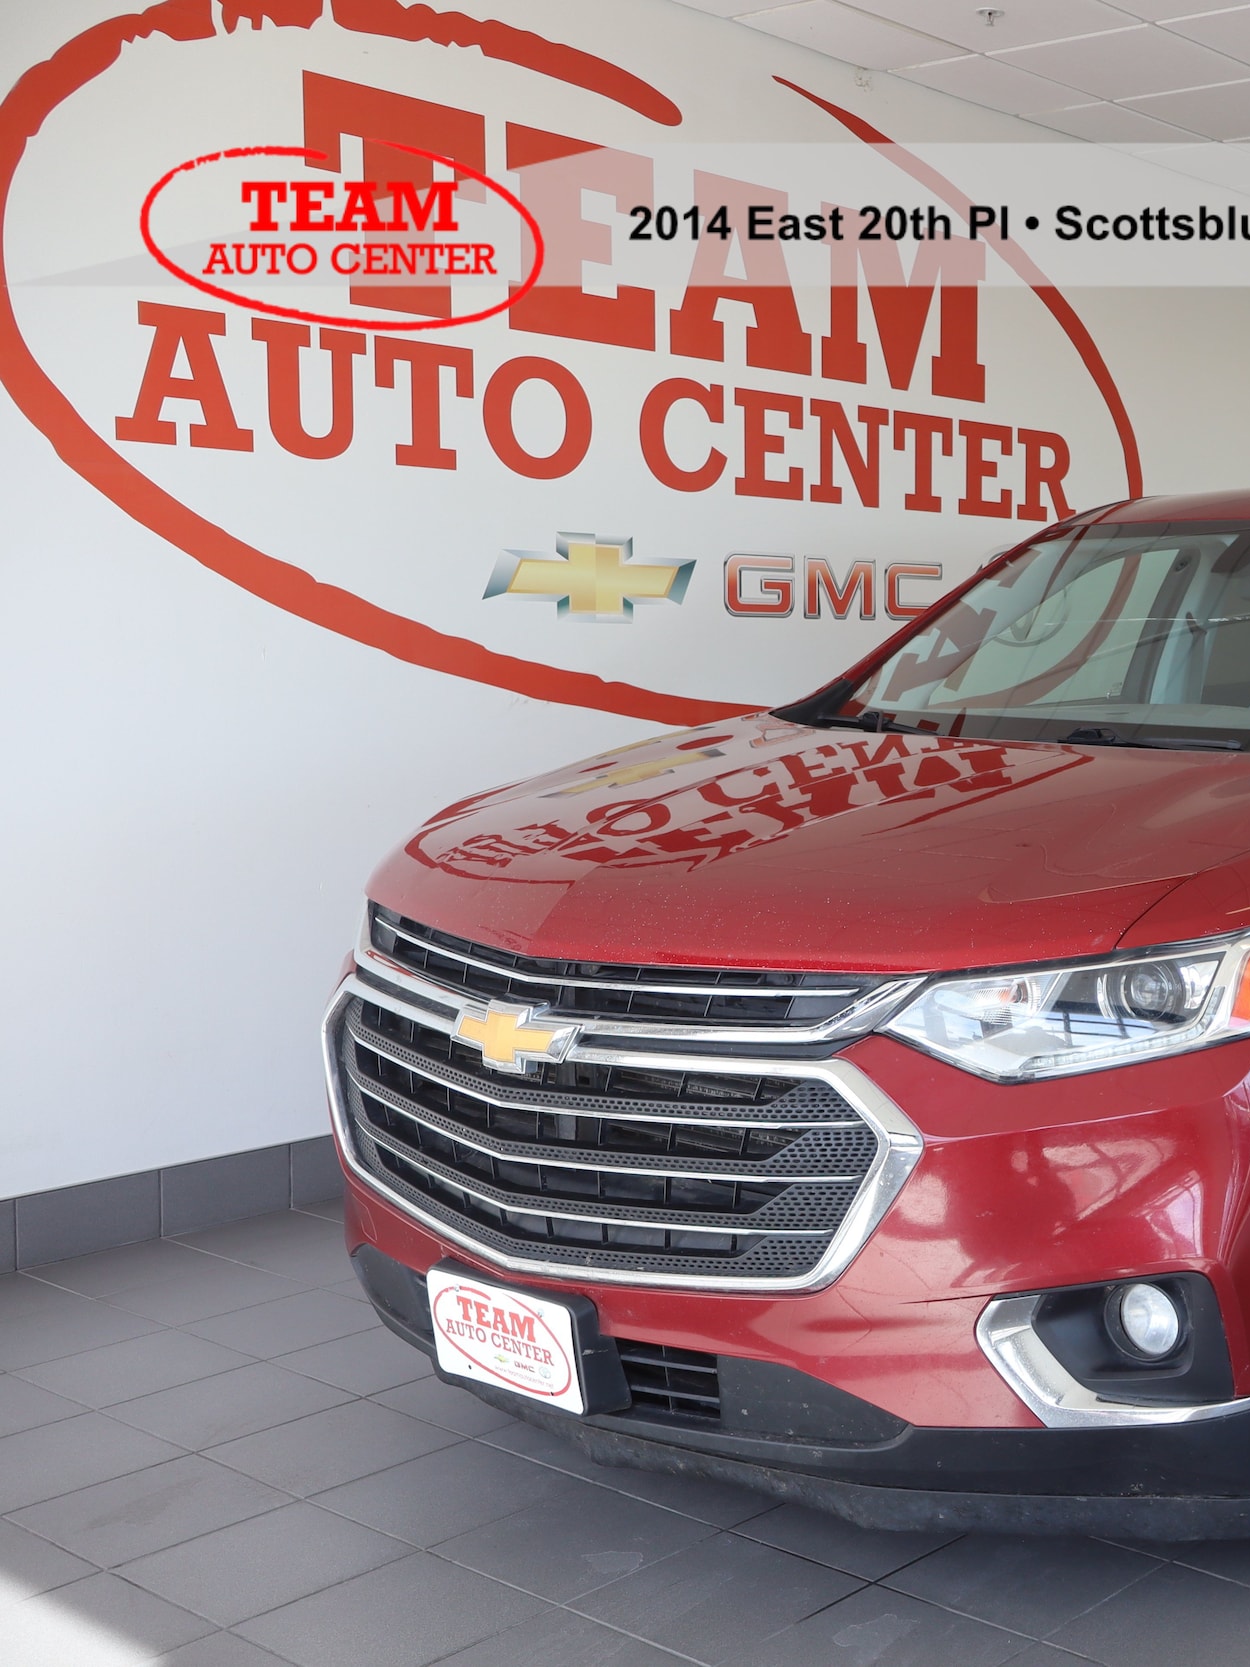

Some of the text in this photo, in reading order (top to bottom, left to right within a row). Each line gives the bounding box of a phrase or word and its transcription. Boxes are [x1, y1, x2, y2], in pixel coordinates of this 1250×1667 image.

[302, 70, 986, 403] TEAM
[115, 300, 1076, 522] AUTO CENTER
[723, 553, 943, 621] GMC
[446, 1318, 555, 1366] AUTO CENTER
[456, 1295, 536, 1343] TEAM
[514, 1361, 535, 1373] GMC
